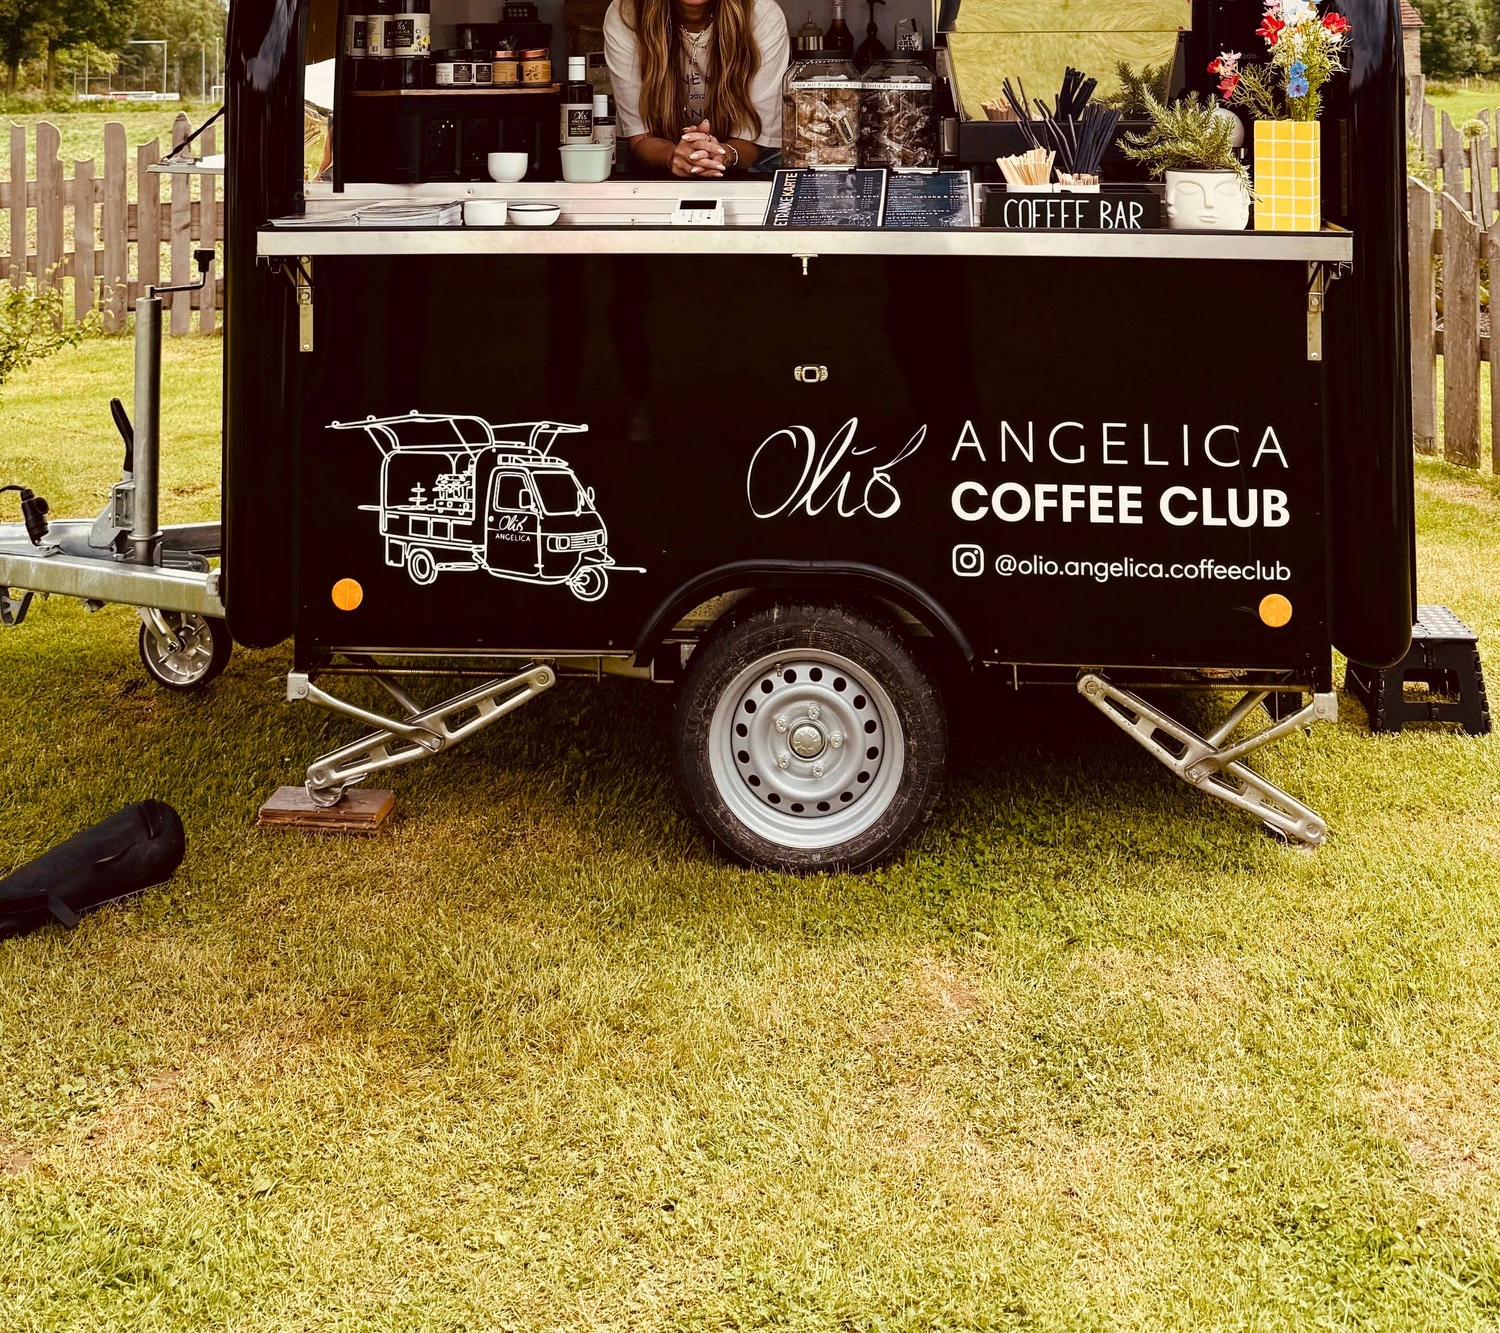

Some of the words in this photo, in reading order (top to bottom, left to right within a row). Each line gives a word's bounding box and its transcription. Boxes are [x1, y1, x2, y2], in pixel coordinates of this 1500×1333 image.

[773, 172, 798, 226] ETRÄNKEKARTE
[1099, 200, 1144, 228] BAR
[951, 419, 1290, 469] ANGELICA
[951, 481, 1144, 525] COFFEE
[1159, 485, 1291, 528] CLUB
[494, 533, 531, 542] ANGELICA
[994, 554, 1291, 583] @olio.angelica.coffeeclub
